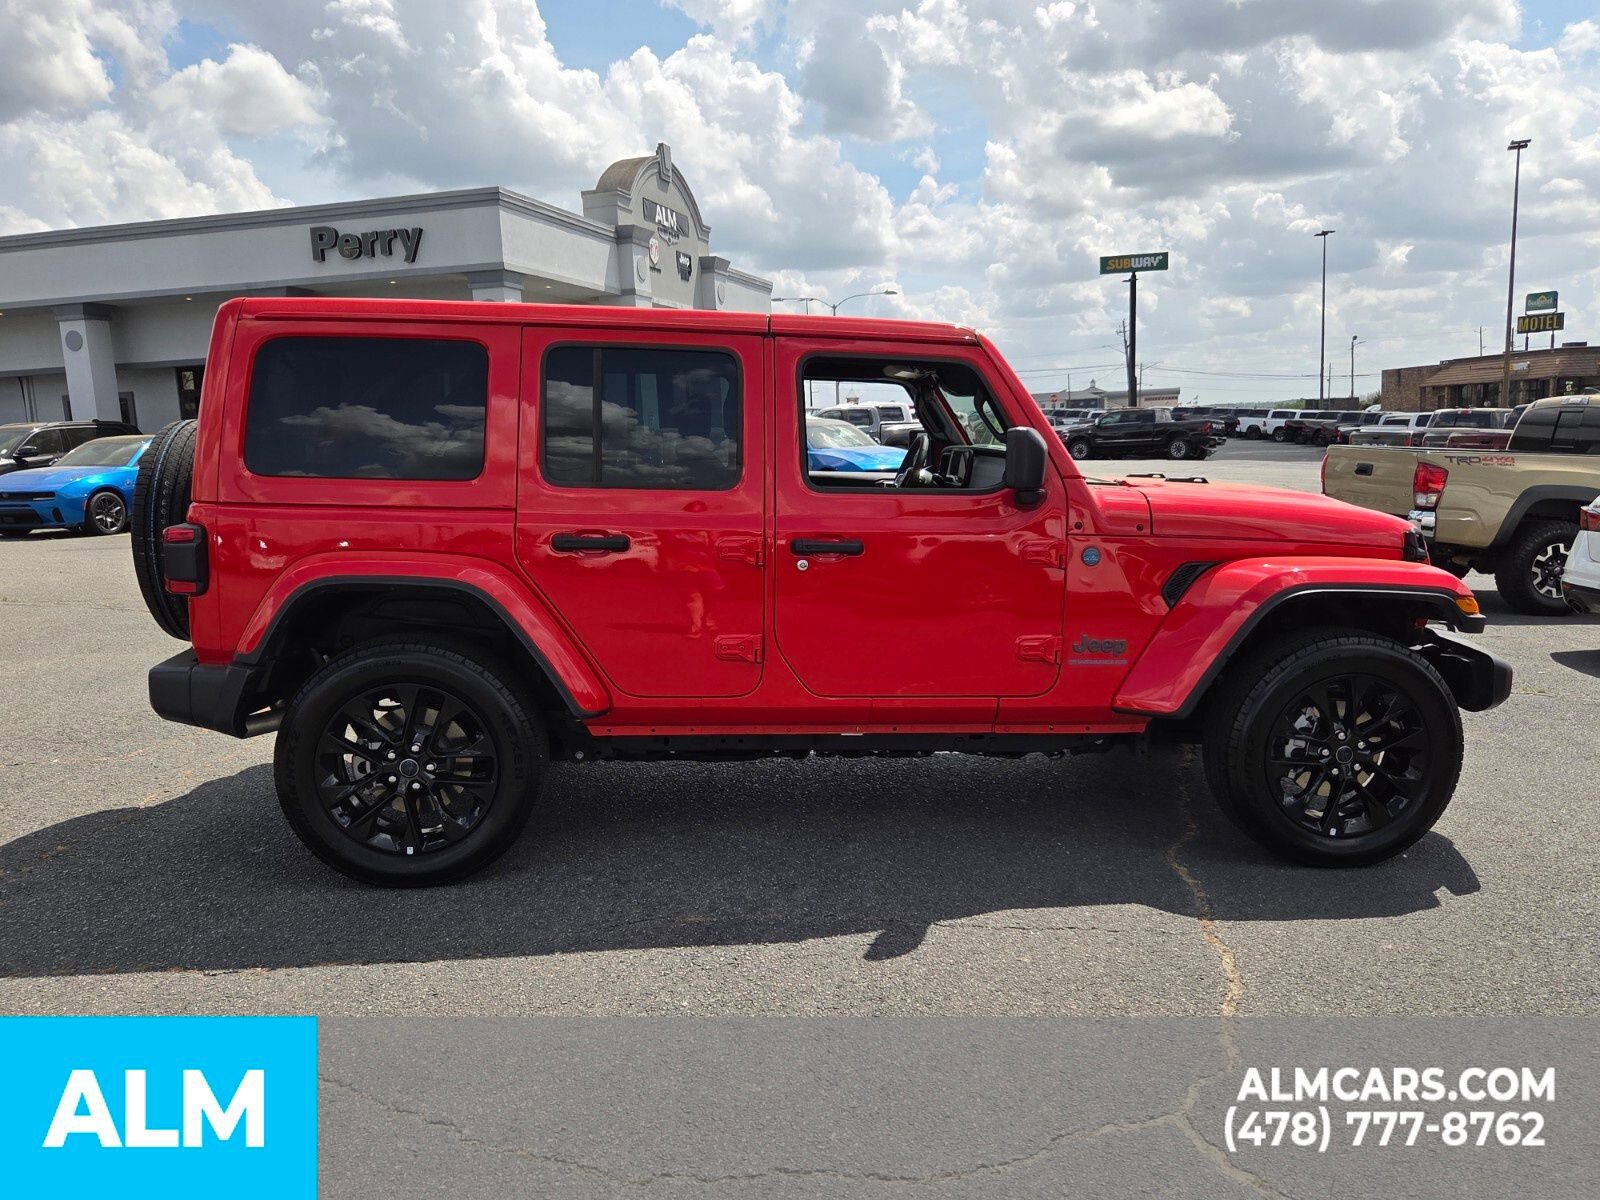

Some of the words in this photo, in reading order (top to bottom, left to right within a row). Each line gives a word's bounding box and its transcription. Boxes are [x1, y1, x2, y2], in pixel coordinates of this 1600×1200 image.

[655, 204, 678, 231] ALM
[310, 226, 423, 264] Perry
[1106, 254, 1163, 271] SUBWAY
[1518, 314, 1560, 332] MOTEL
[1444, 455, 1481, 466] TRD
[1072, 633, 1128, 657] Jeep
